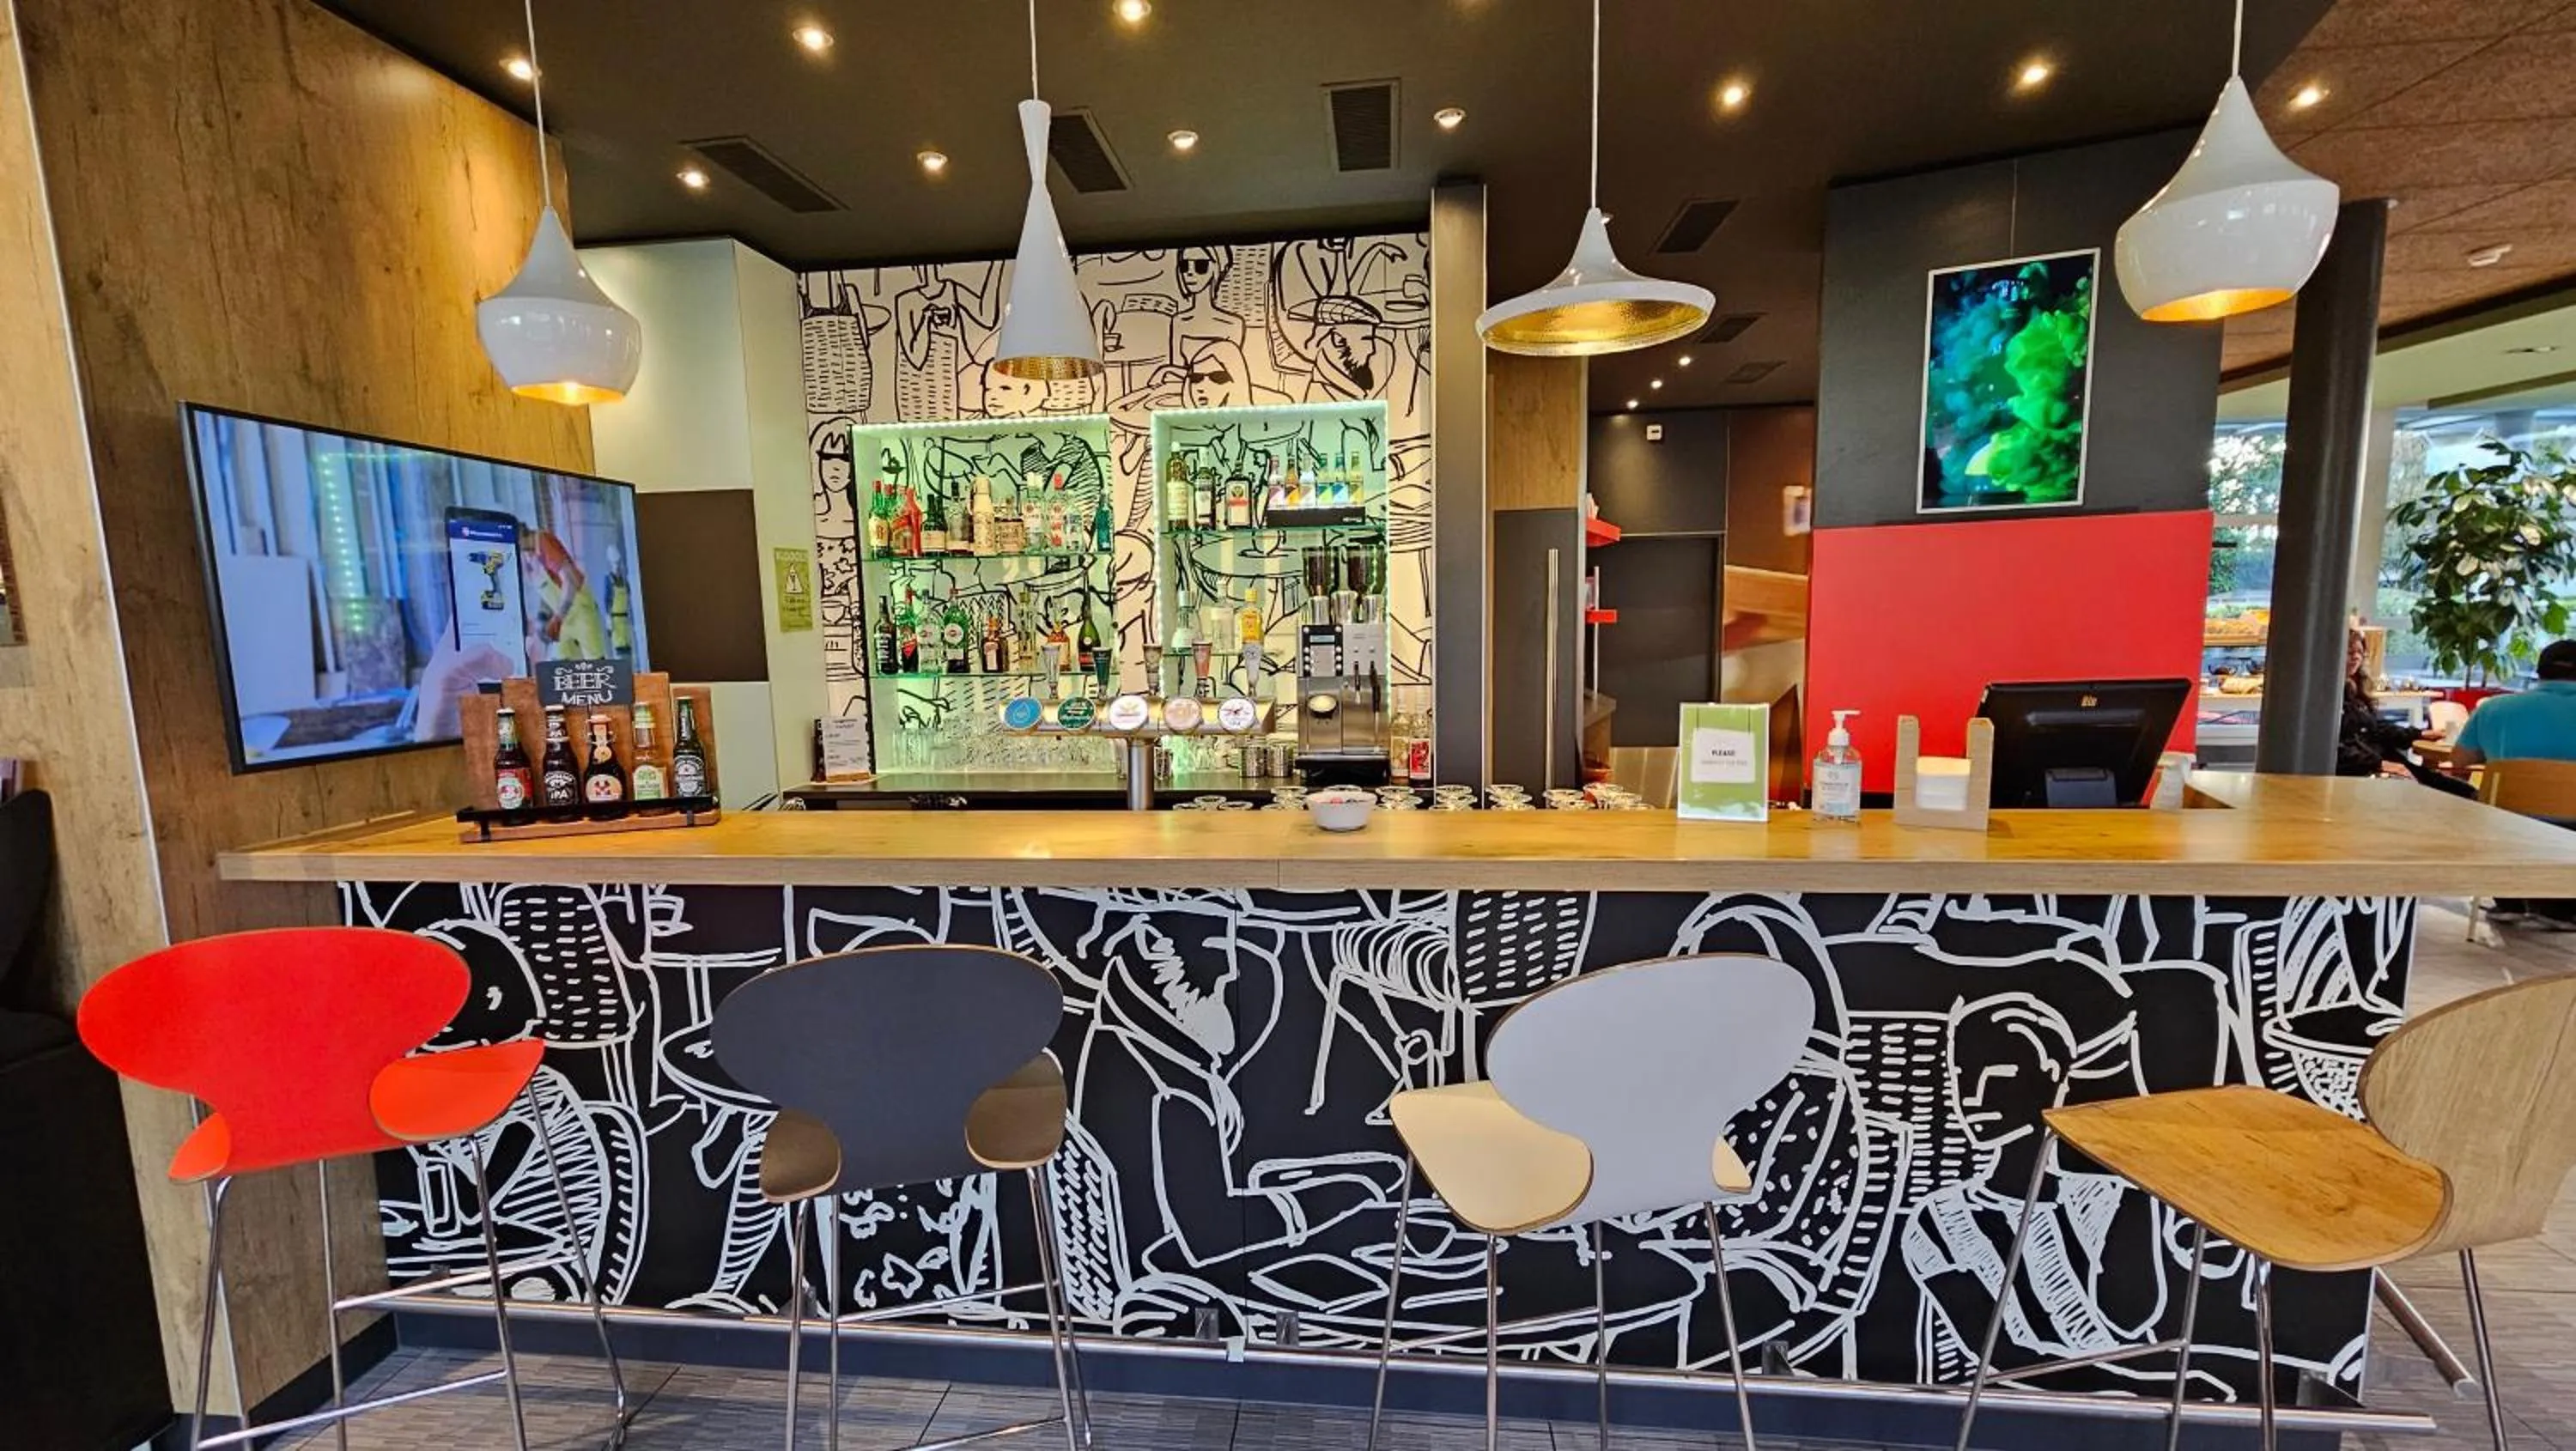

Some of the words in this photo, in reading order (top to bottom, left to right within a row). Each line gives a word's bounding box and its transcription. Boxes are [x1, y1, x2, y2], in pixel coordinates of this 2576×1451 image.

[553, 672, 617, 690] BEER
[561, 689, 612, 707] MENU
[550, 789, 568, 799] IPA
